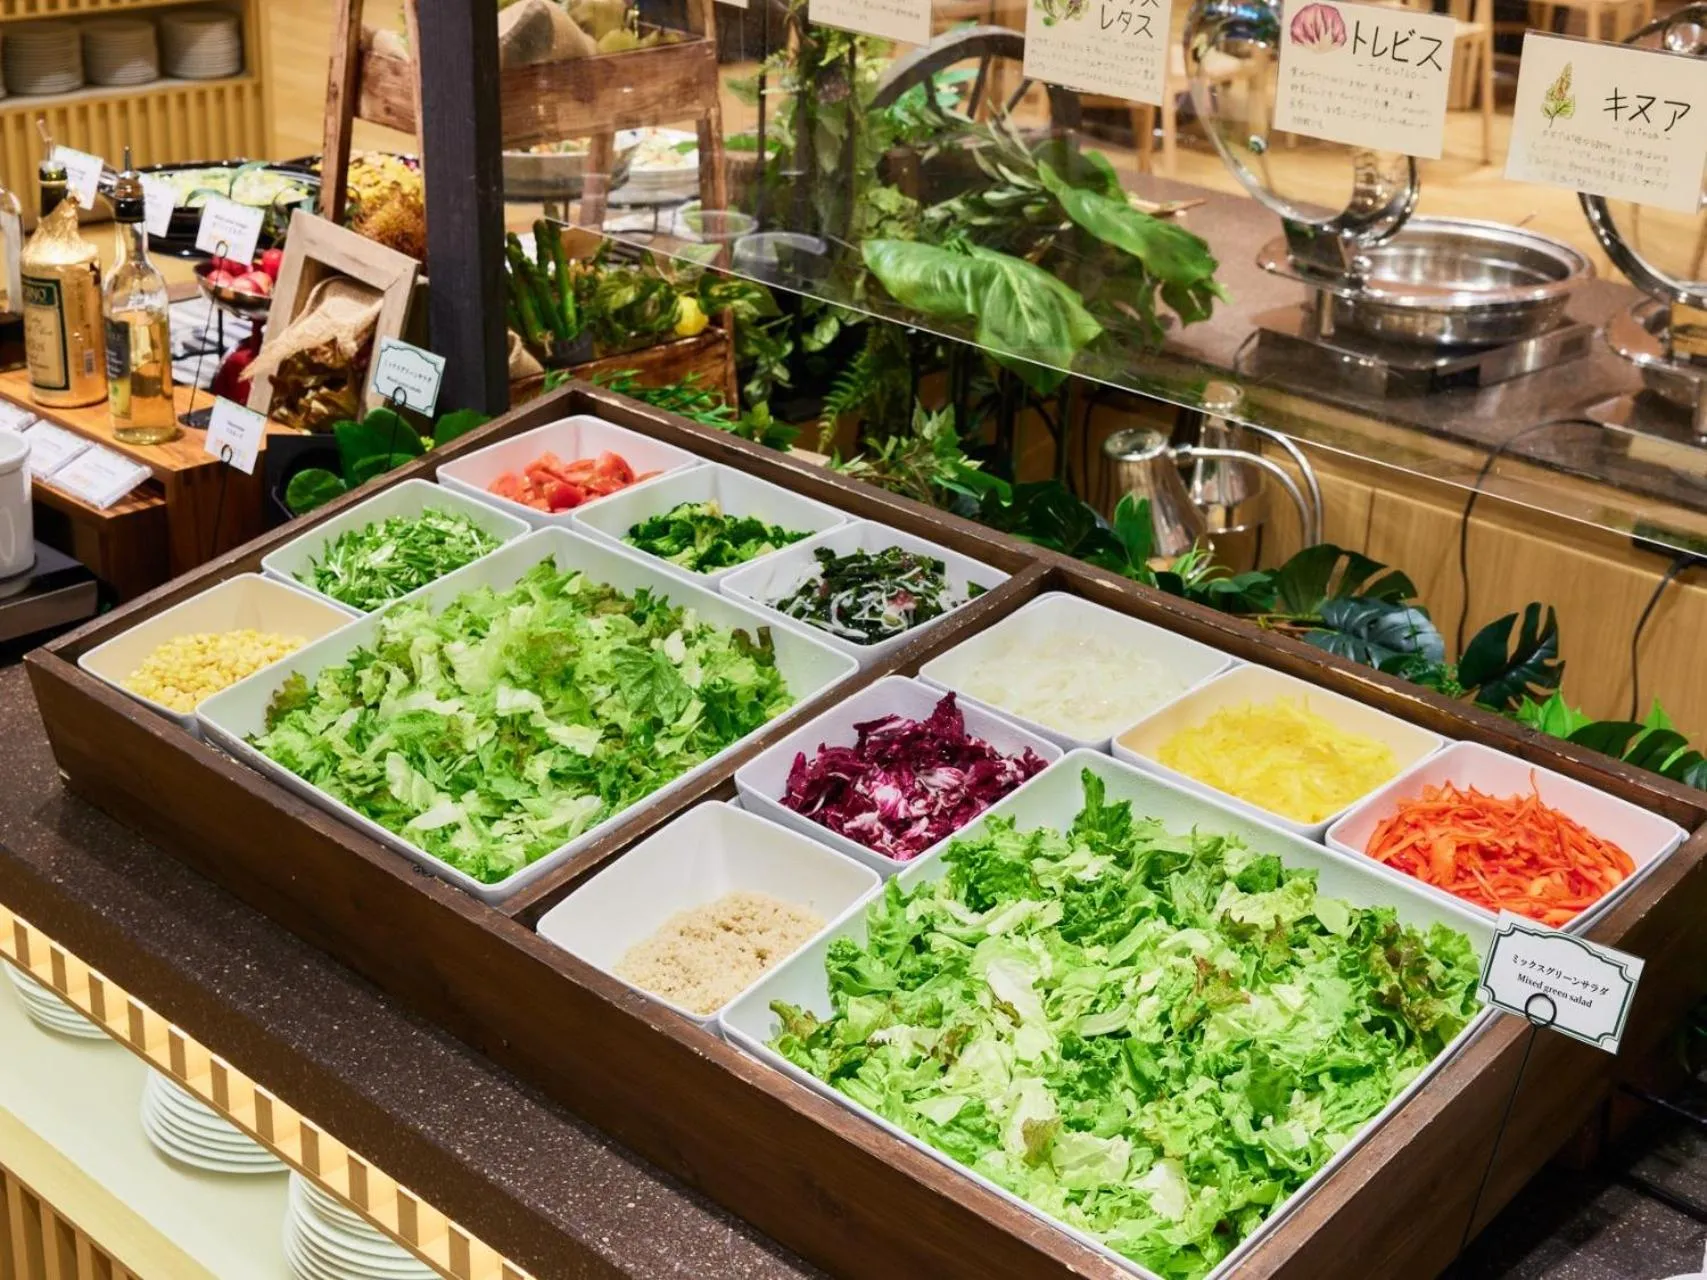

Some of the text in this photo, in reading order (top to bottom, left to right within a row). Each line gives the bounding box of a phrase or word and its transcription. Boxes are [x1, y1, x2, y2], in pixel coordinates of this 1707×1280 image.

[1101, 4, 1154, 39] レタス
[1352, 20, 1443, 72] トレビス
[1602, 86, 1692, 132] キヌア
[1511, 953, 1611, 997] ミックスグリーンサラダ
[1517, 972, 1594, 1009] Mixed green salad
